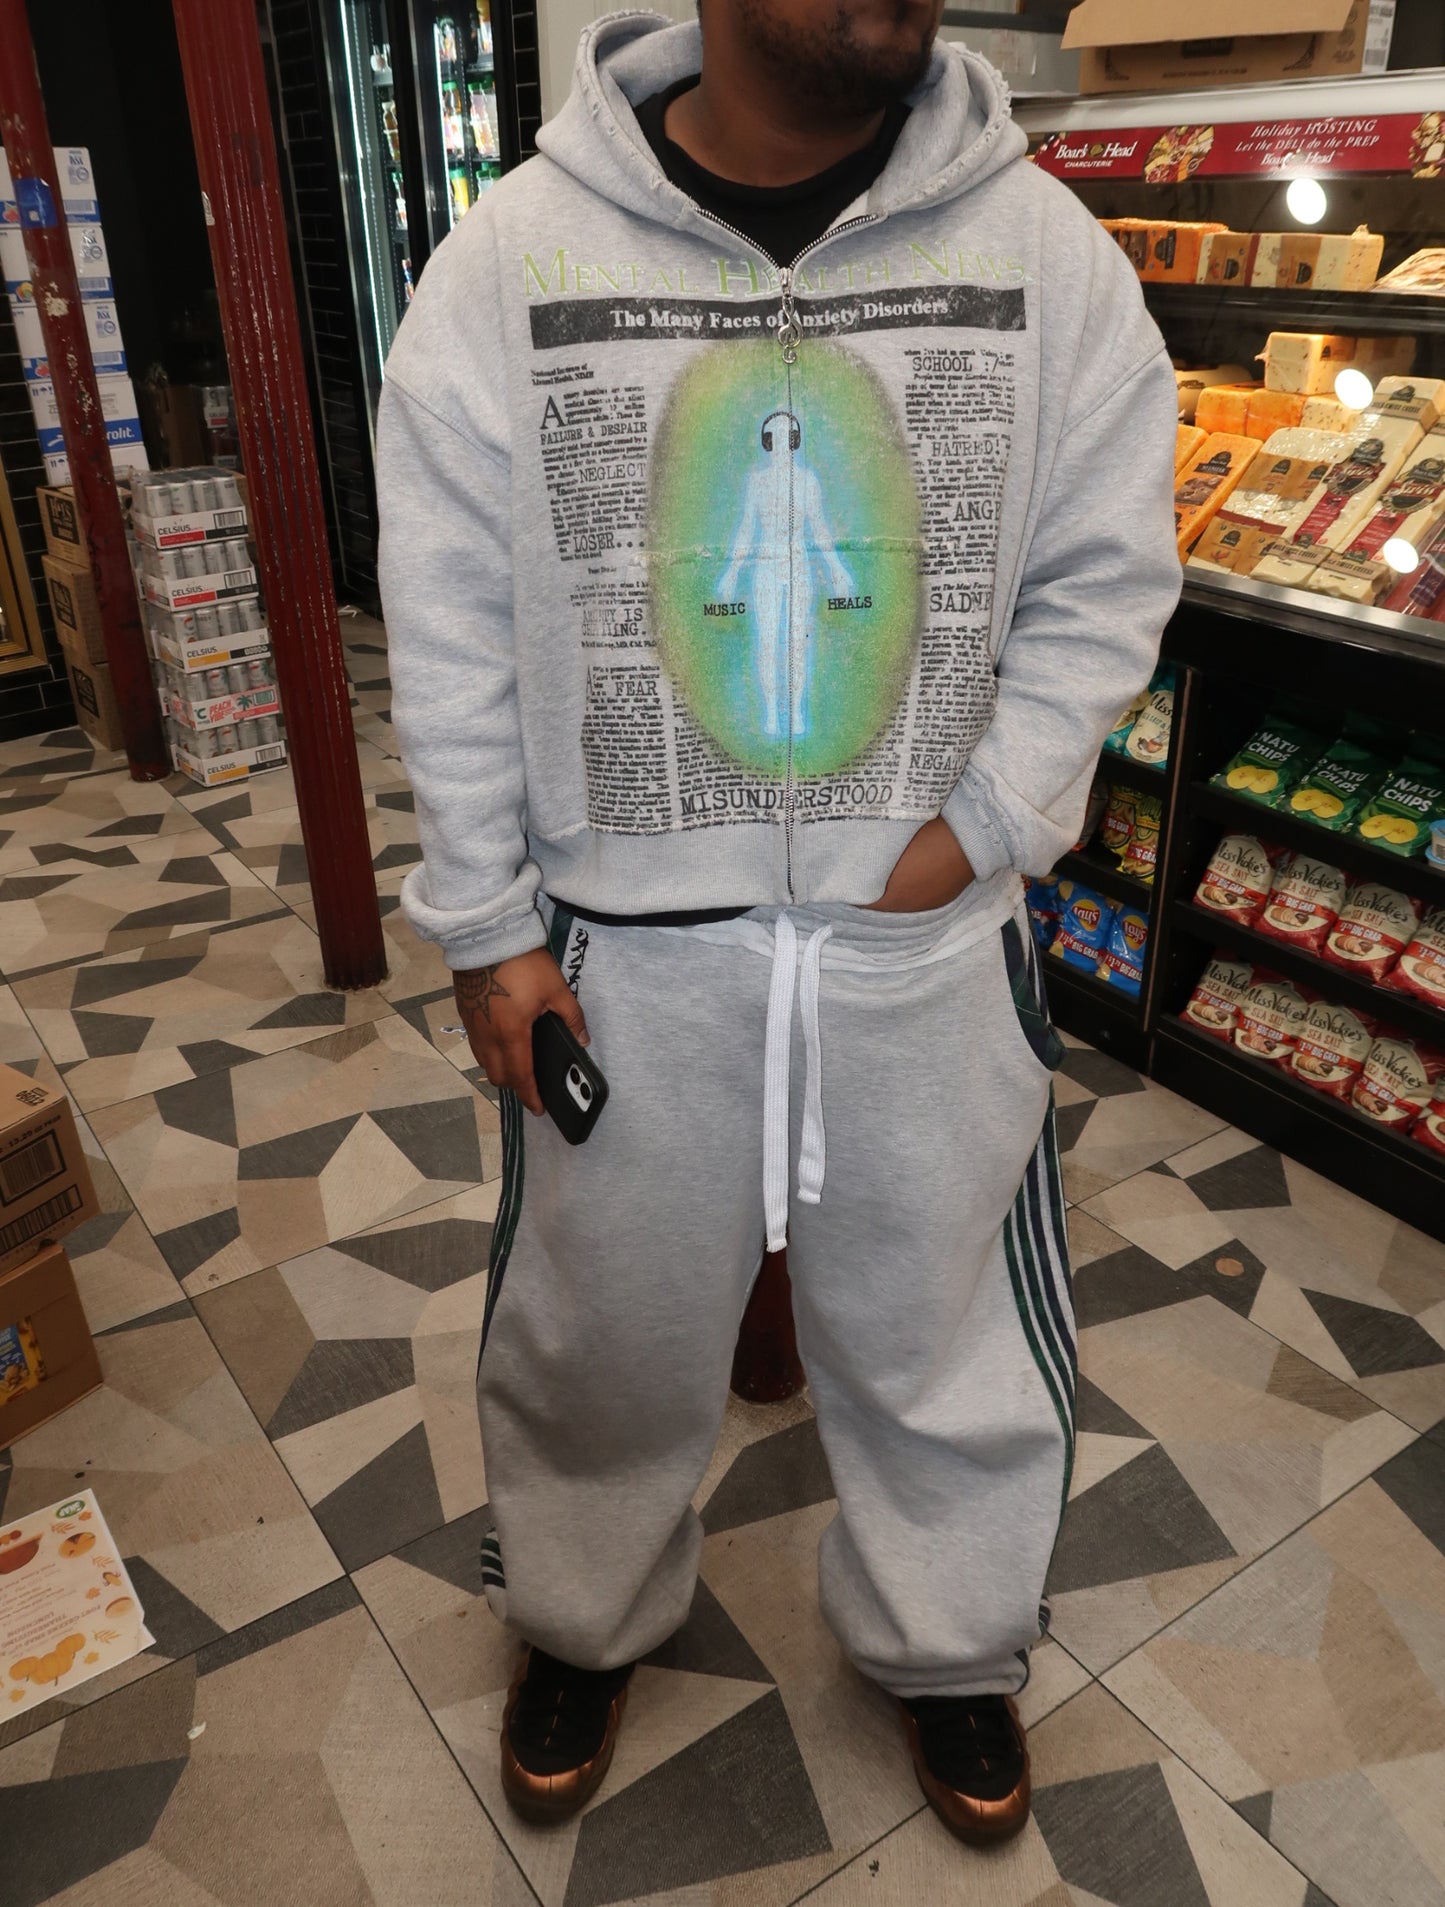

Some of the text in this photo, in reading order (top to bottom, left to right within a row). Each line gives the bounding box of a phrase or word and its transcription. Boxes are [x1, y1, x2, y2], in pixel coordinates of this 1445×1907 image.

[1250, 117, 1378, 140] Holiday HOSTING
[1102, 140, 1138, 159] Head
[1235, 134, 1380, 153] Let the DELI do the PREP
[1064, 159, 1114, 170] CHARCUTERIE
[521, 245, 688, 303] MENTAL
[907, 237, 1033, 287] NEWS
[609, 309, 646, 328] The
[650, 311, 703, 335] Many
[709, 312, 761, 329] Faces
[862, 297, 949, 323] Disorders
[912, 355, 974, 373] SCHOOL
[540, 421, 648, 446] FAILURE & DESPAIR
[579, 462, 647, 486] NEGLECT
[157, 524, 191, 538] CELSIUS
[171, 585, 204, 600] CELSIUS
[624, 607, 643, 622] IS
[703, 595, 873, 618] MUSIC HEALS
[186, 647, 218, 661] CELSIUS
[615, 680, 659, 697] FEAR
[1247, 741, 1292, 764] CHIPS
[1256, 731, 1301, 755] NATU
[206, 762, 237, 777] CELSIUS
[1314, 765, 1362, 794] CHIPS
[1325, 761, 1370, 784] NATU
[1393, 777, 1444, 800] NATU
[1382, 788, 1434, 814] CHIPS
[1073, 906, 1099, 926] Lay's
[1297, 899, 1317, 915] GRAB
[1125, 921, 1148, 943] Lay's
[1363, 927, 1383, 944] GRAB
[1083, 944, 1099, 962] GRAB
[1204, 978, 1241, 1002] SEA SALT
[1306, 1028, 1343, 1051] SEA SALT
[1321, 1048, 1341, 1066] GRAB
